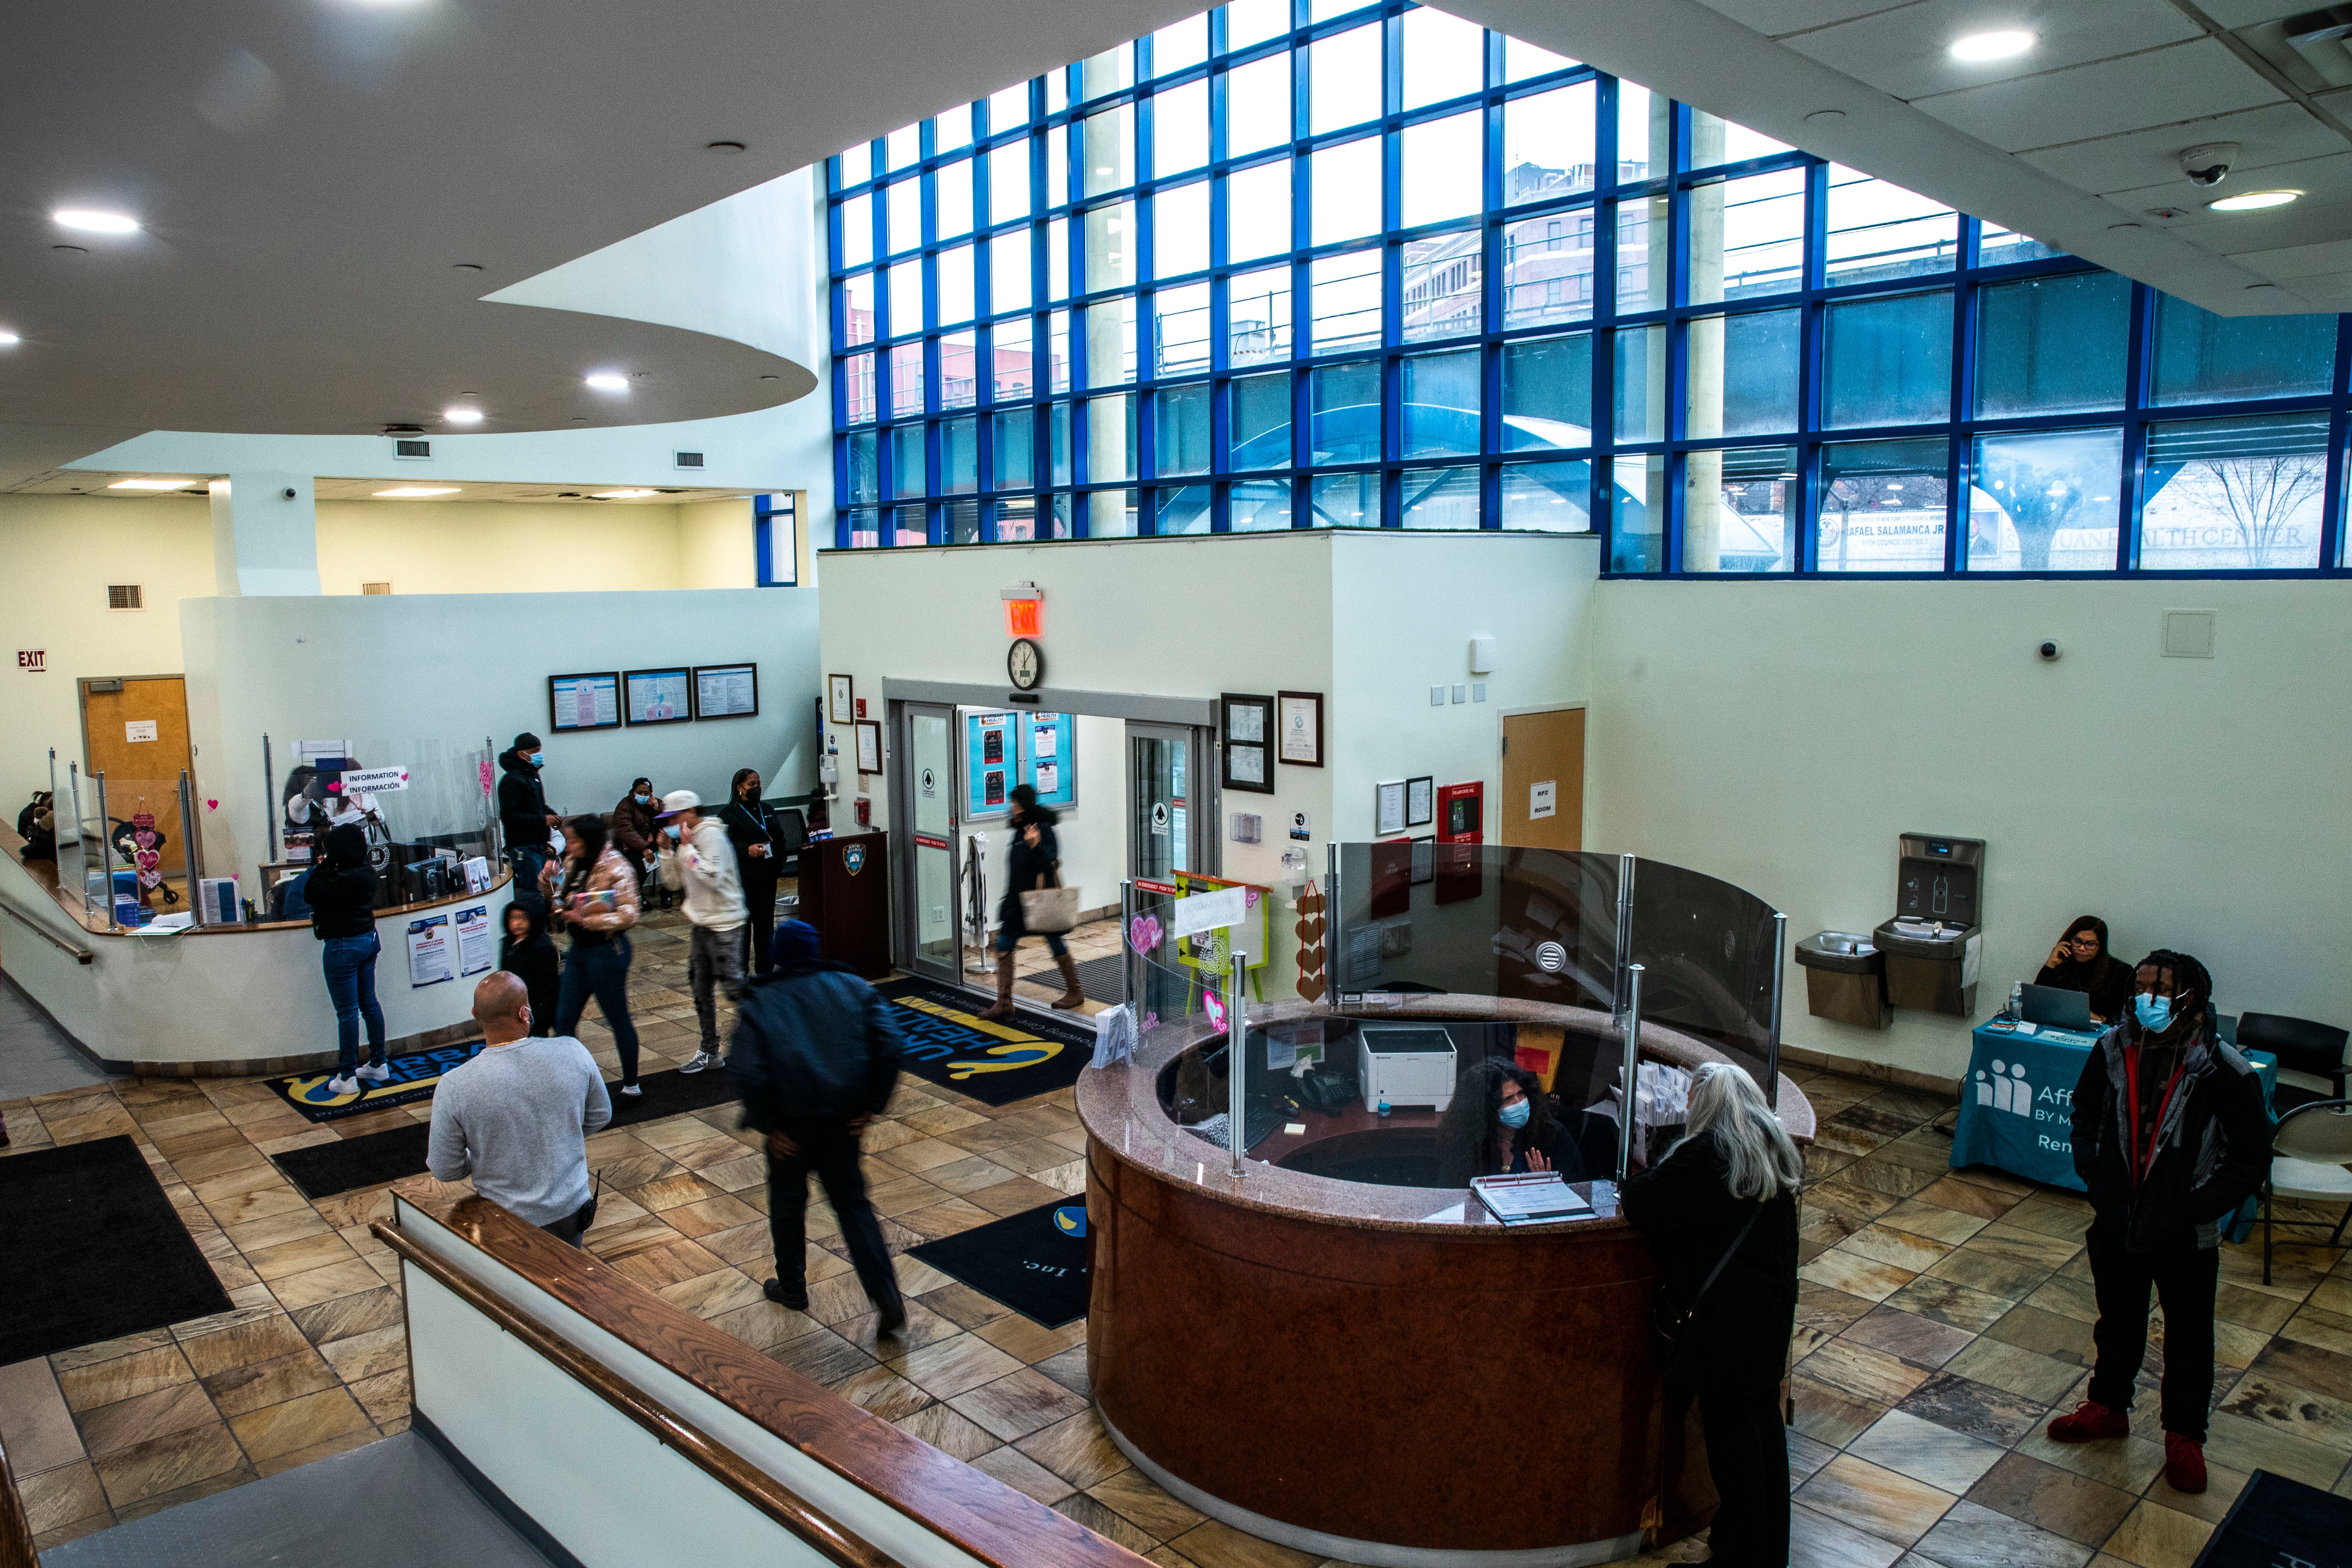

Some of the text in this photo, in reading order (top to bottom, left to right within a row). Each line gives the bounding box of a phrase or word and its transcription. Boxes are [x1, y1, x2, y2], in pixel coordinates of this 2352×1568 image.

[1877, 525, 1930, 535] SALAMANCA
[2201, 526, 2304, 545] CENTER
[1010, 602, 1037, 634] EXIT
[18, 651, 45, 667] EXIT
[349, 771, 399, 782] INFORMATION
[350, 782, 400, 793] INFORMACIÓN
[1534, 805, 1551, 813] ROOM
[2038, 1086, 2074, 1107] Aff
[315, 1098, 396, 1117] Providing
[2035, 1109, 2071, 1126] BY M
[2039, 1134, 2073, 1153] Ren
[1023, 1261, 1069, 1277] Inc.
